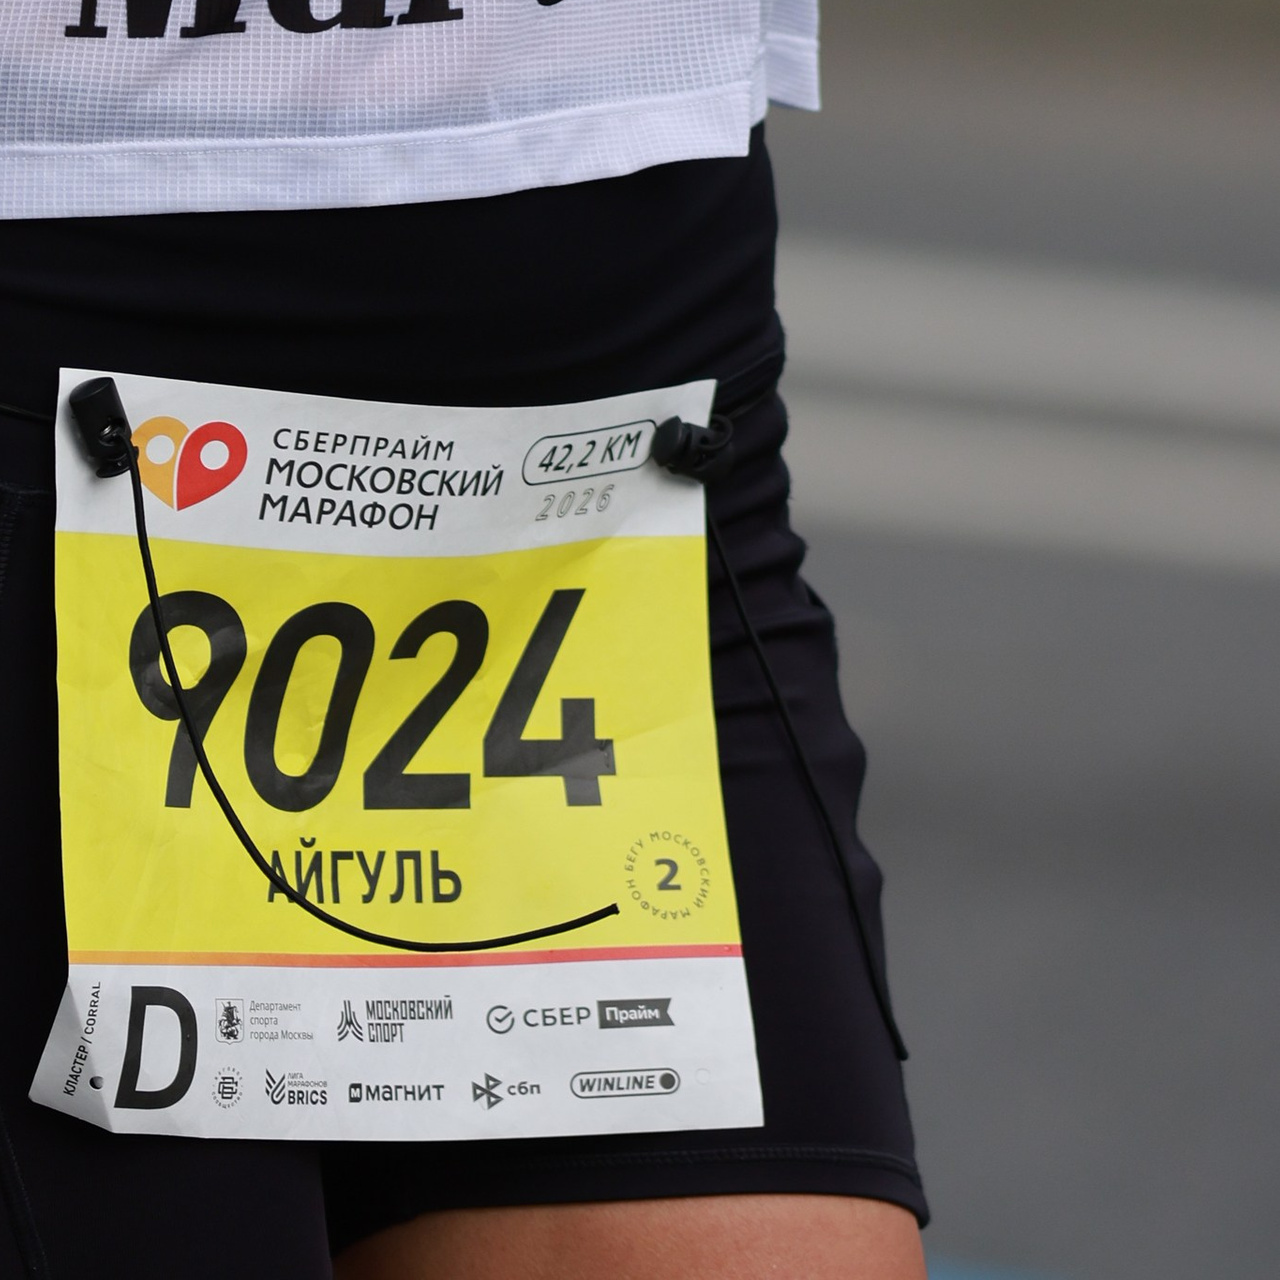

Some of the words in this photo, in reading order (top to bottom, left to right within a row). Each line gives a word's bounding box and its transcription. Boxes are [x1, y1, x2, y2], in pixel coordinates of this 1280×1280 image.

[272, 427, 455, 461] СБЕРПРАЙМ
[538, 440, 597, 474] 42,2
[600, 430, 642, 464] КМ
[265, 457, 505, 497] МОСКОВСКИЙ
[258, 493, 439, 530] МАРАФОН
[535, 484, 615, 521] 2026
[128, 588, 617, 813] 9024
[267, 837, 462, 904] АЙГУЛЬ
[654, 858, 682, 891] 2
[249, 1000, 302, 1012] Департамент
[365, 995, 453, 1020] МОСКОВСКИЙ
[523, 1006, 591, 1027] СБЕР
[605, 1005, 660, 1023] Прайм
[250, 1016, 278, 1026] спорта
[368, 1023, 405, 1042] СПОРТ
[63, 1045, 89, 1096] КЛАСТЕР
[84, 981, 101, 1035] CORRAL
[114, 986, 198, 1110] D
[250, 1031, 279, 1041] города
[281, 1030, 314, 1040] Москвы
[287, 1072, 304, 1080] ЛИГА
[287, 1080, 328, 1088] МАРАФОНОВ
[507, 1081, 541, 1096] сбп
[579, 1075, 656, 1093] WINLINE
[287, 1090, 327, 1105] BRICS
